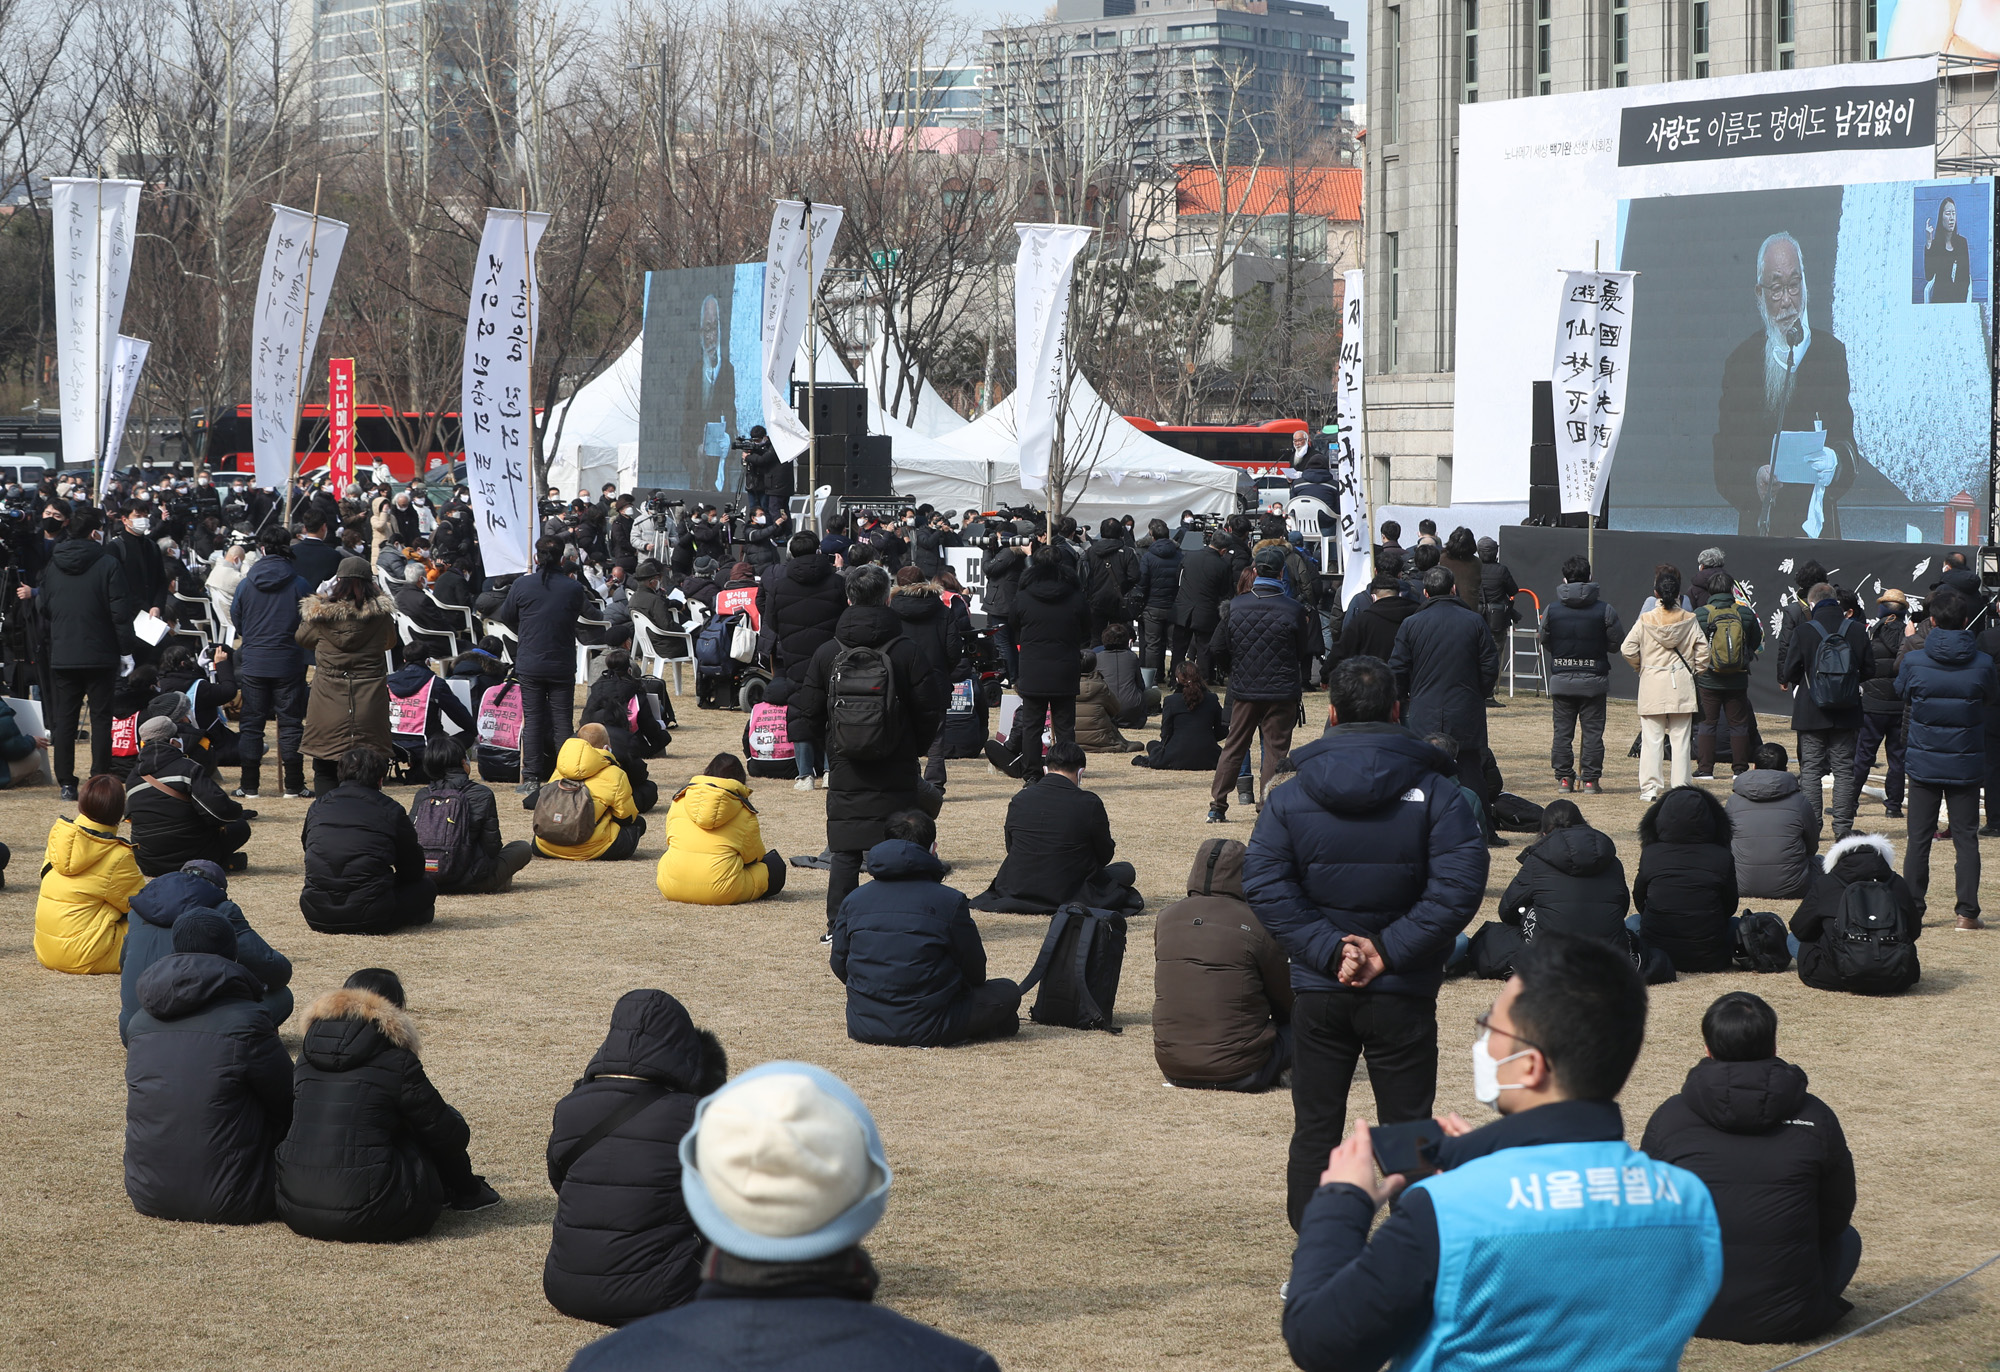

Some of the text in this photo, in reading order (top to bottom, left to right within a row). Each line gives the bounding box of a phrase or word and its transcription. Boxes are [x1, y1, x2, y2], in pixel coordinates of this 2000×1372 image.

[1504, 136, 1614, 161] 노나메기 세상 백기완 선생 사회장
[1646, 98, 1915, 153] 사랑도 이름도 명예도 남김없이
[336, 368, 348, 498] 노나메기 세상
[726, 591, 748, 599] 탈시설
[1506, 1166, 1682, 1212] 서울특별시
